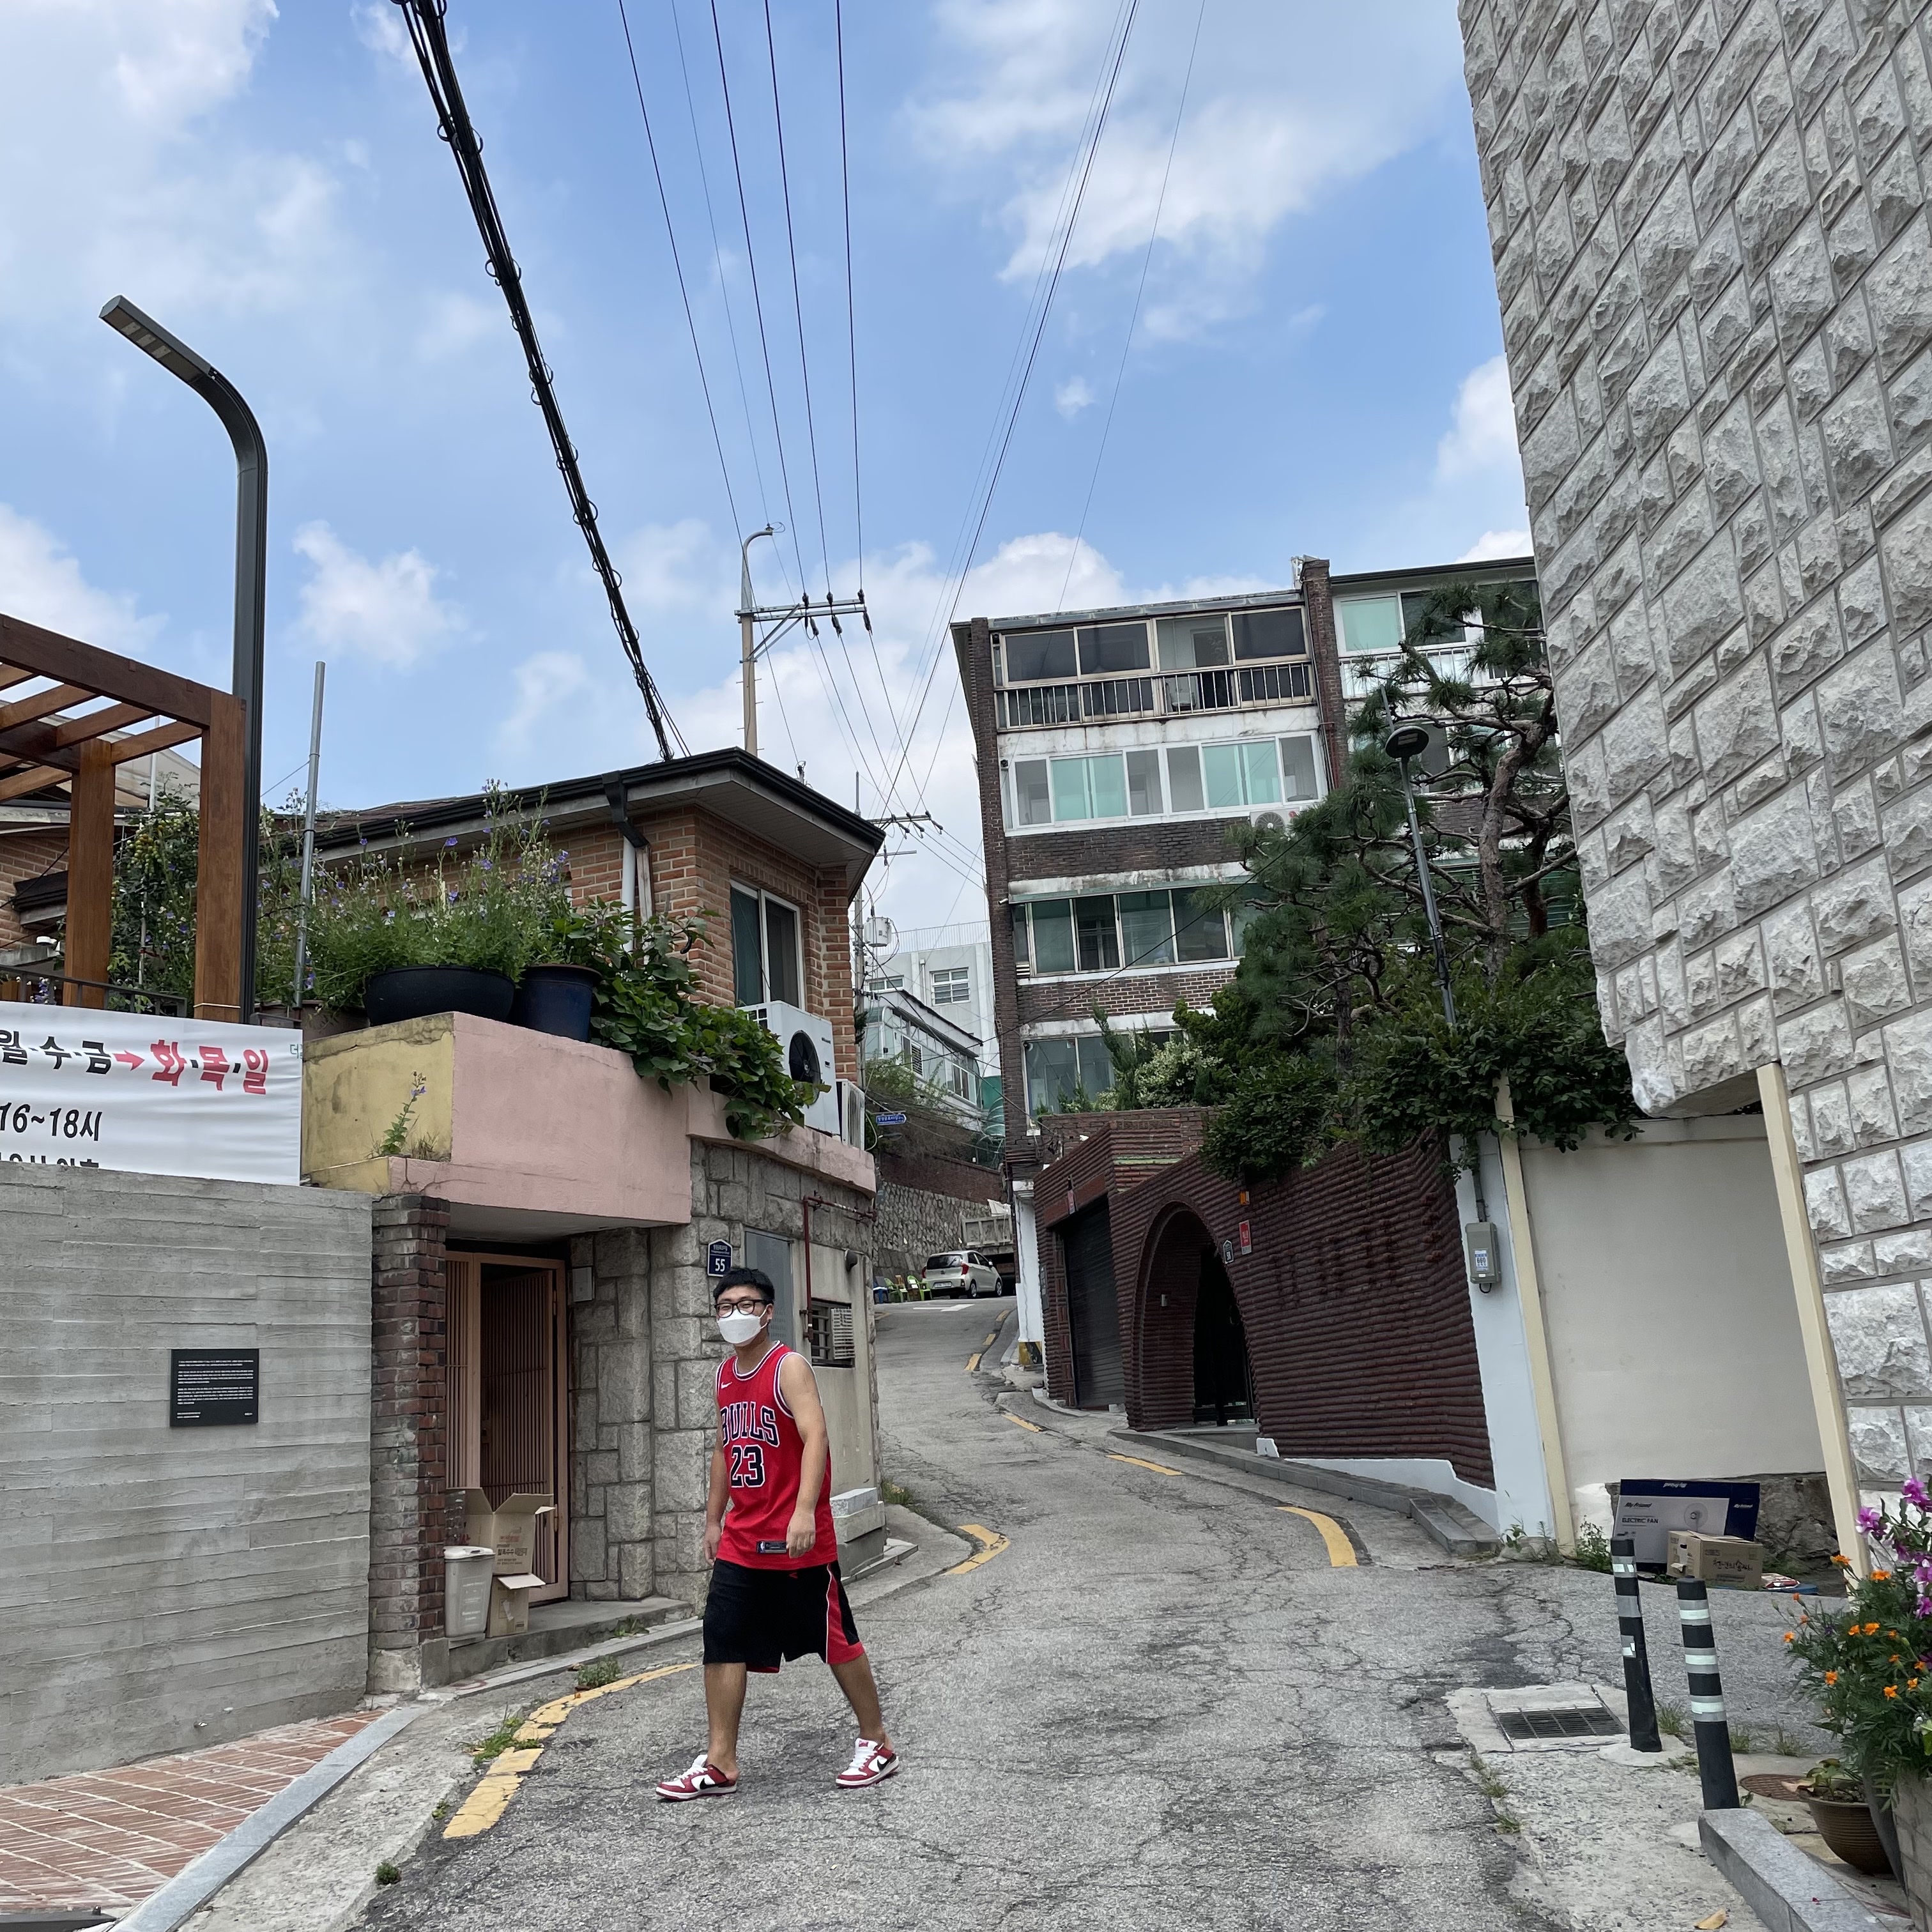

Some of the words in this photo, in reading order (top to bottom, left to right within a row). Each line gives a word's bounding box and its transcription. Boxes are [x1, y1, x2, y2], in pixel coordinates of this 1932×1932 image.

[150, 1039, 268, 1095] 화·목·일
[0, 1102, 103, 1142] 16~18시
[715, 1258, 725, 1272] 55
[730, 1444, 765, 1488] 23
